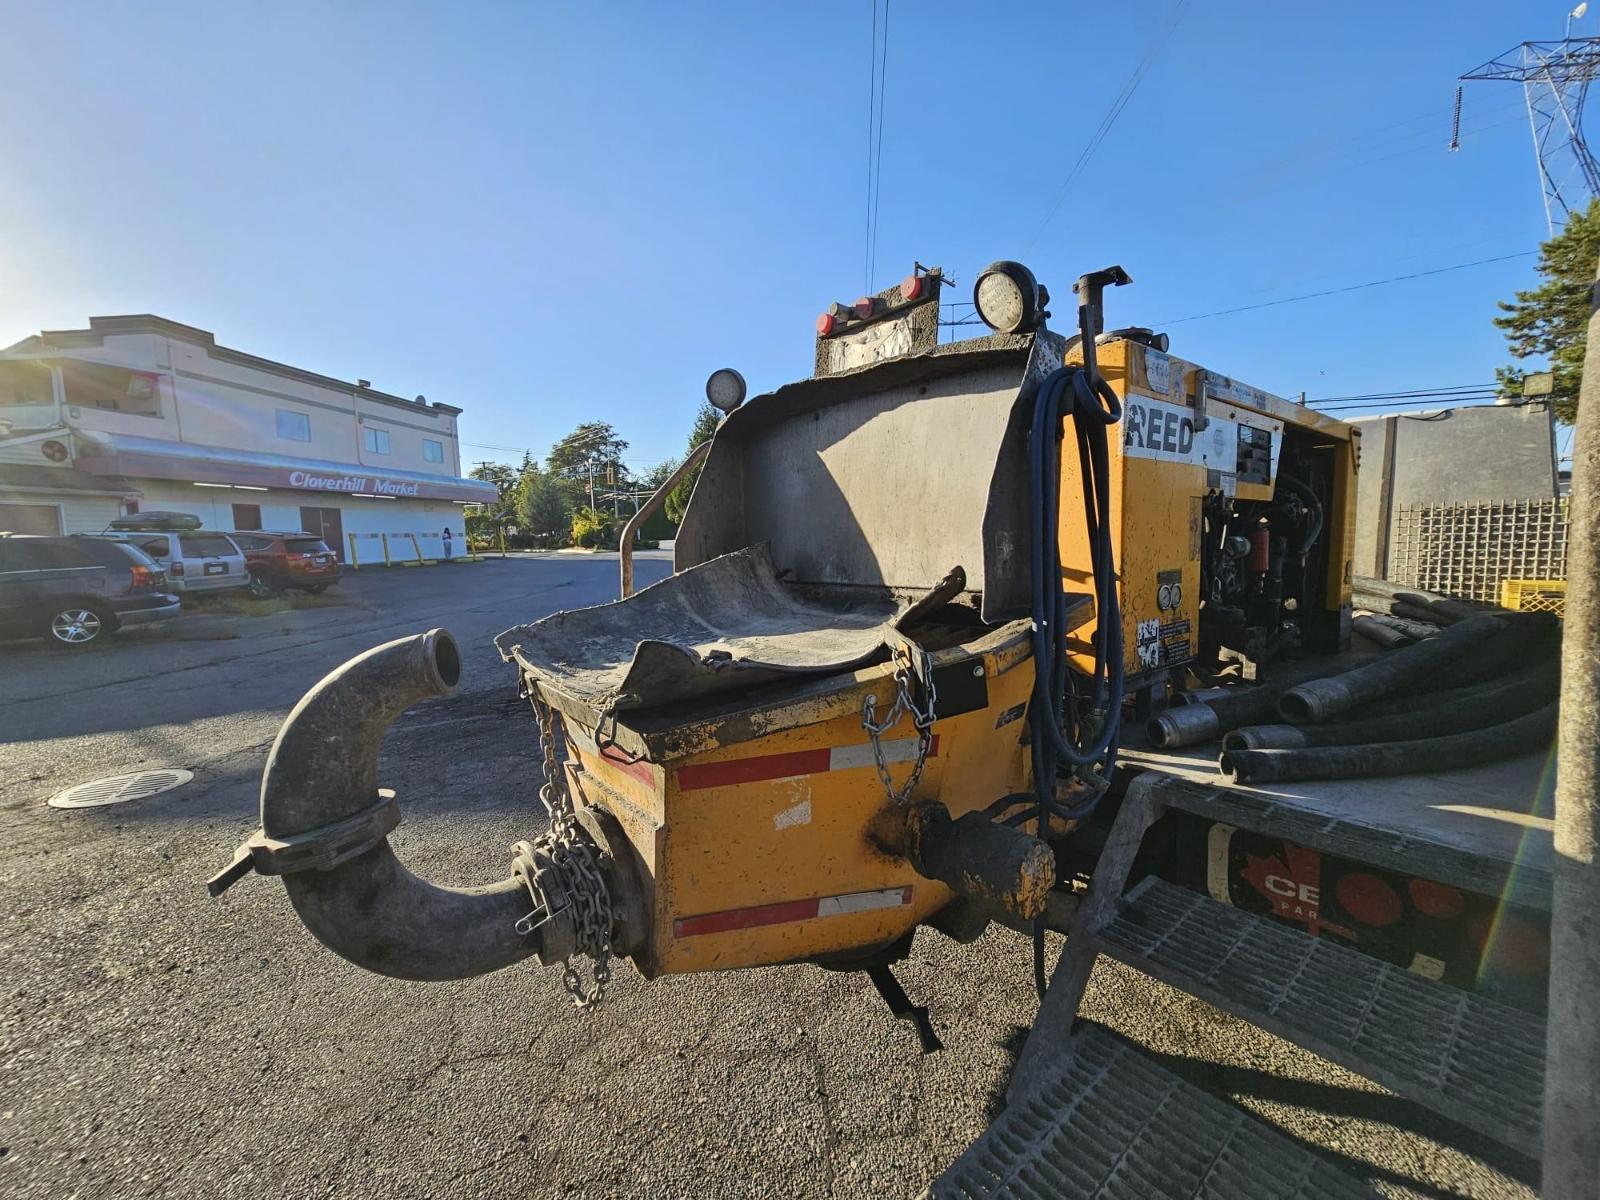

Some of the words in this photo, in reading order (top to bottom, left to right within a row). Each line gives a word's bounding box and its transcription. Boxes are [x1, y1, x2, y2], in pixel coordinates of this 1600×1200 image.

[1125, 404, 1194, 454] REED
[289, 472, 366, 490] Cloverhill
[374, 479, 419, 496] Market
